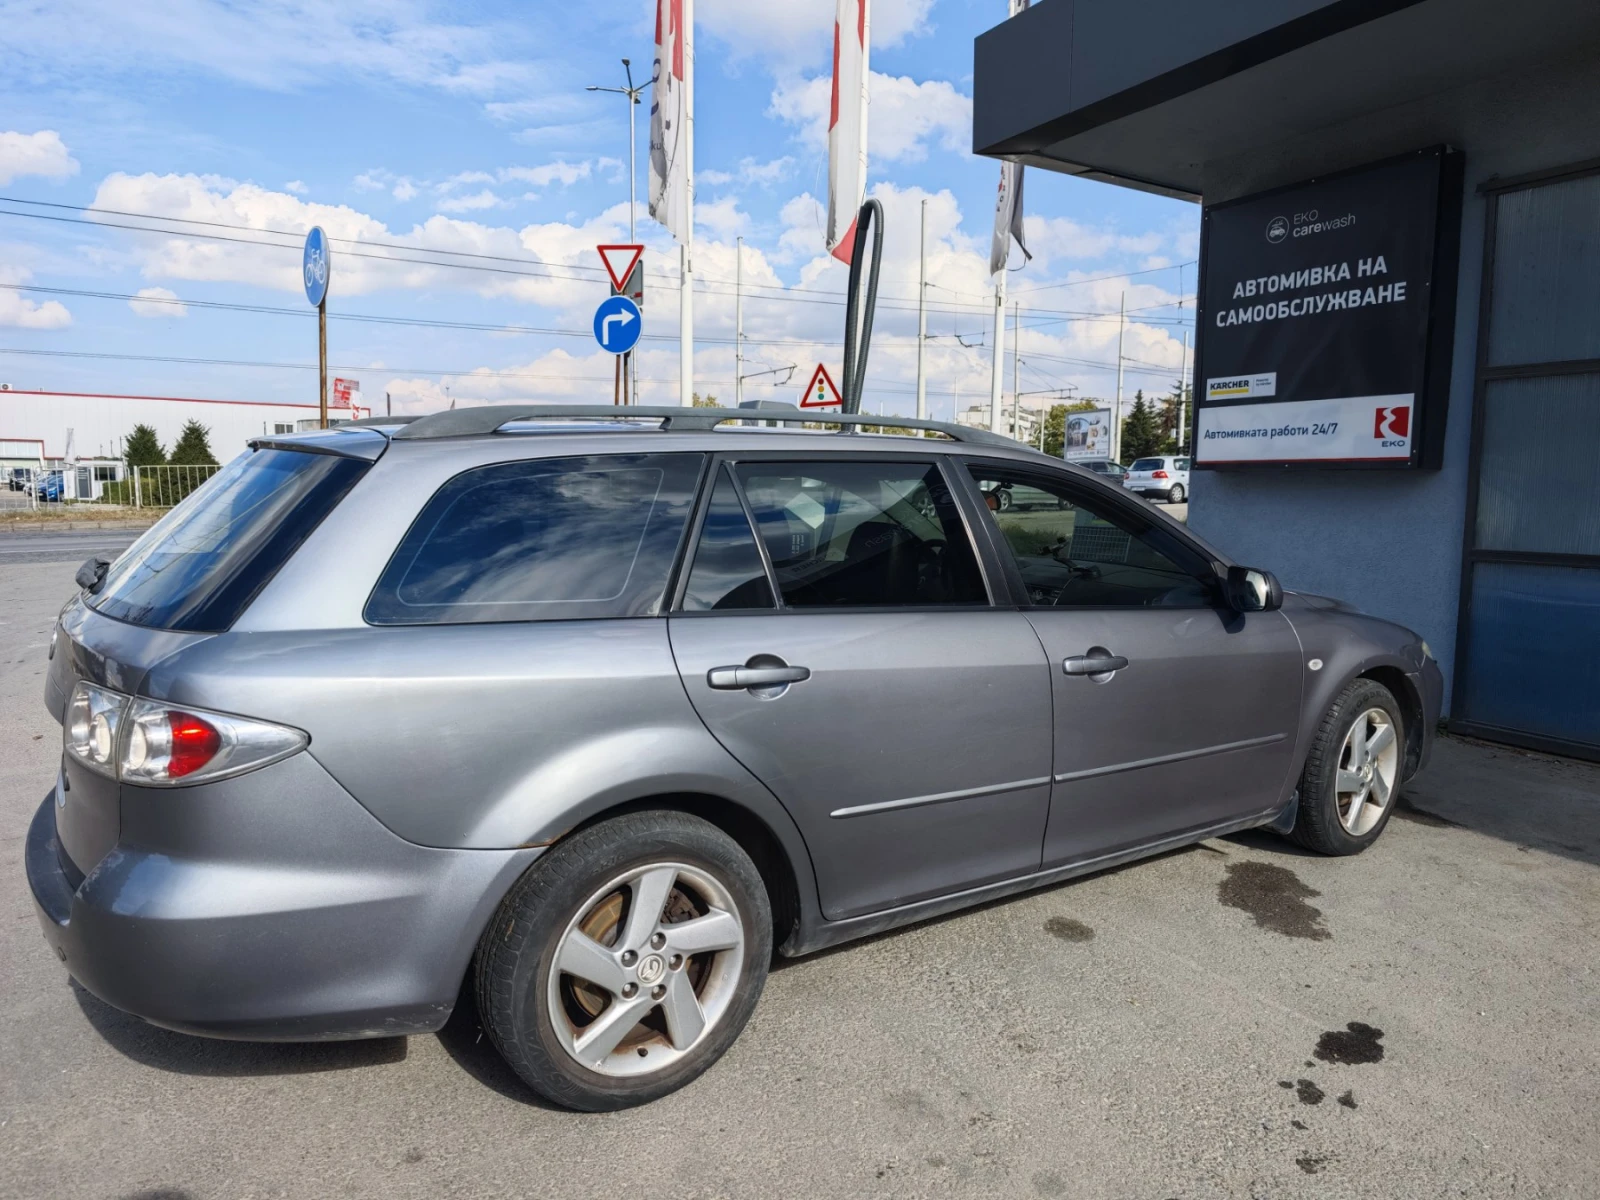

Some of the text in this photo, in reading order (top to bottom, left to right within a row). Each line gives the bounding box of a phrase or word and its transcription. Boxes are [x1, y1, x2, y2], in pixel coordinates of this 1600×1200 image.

[1292, 212, 1356, 237] carewash
[1293, 209, 1319, 225] EKO
[1233, 255, 1388, 299] АВТОМИВКА НА
[1216, 281, 1407, 328] САМООБСЛУЖВАНЕ
[1204, 422, 1338, 440] Автомивката работи 24/7
[1381, 440, 1406, 448] EKO
